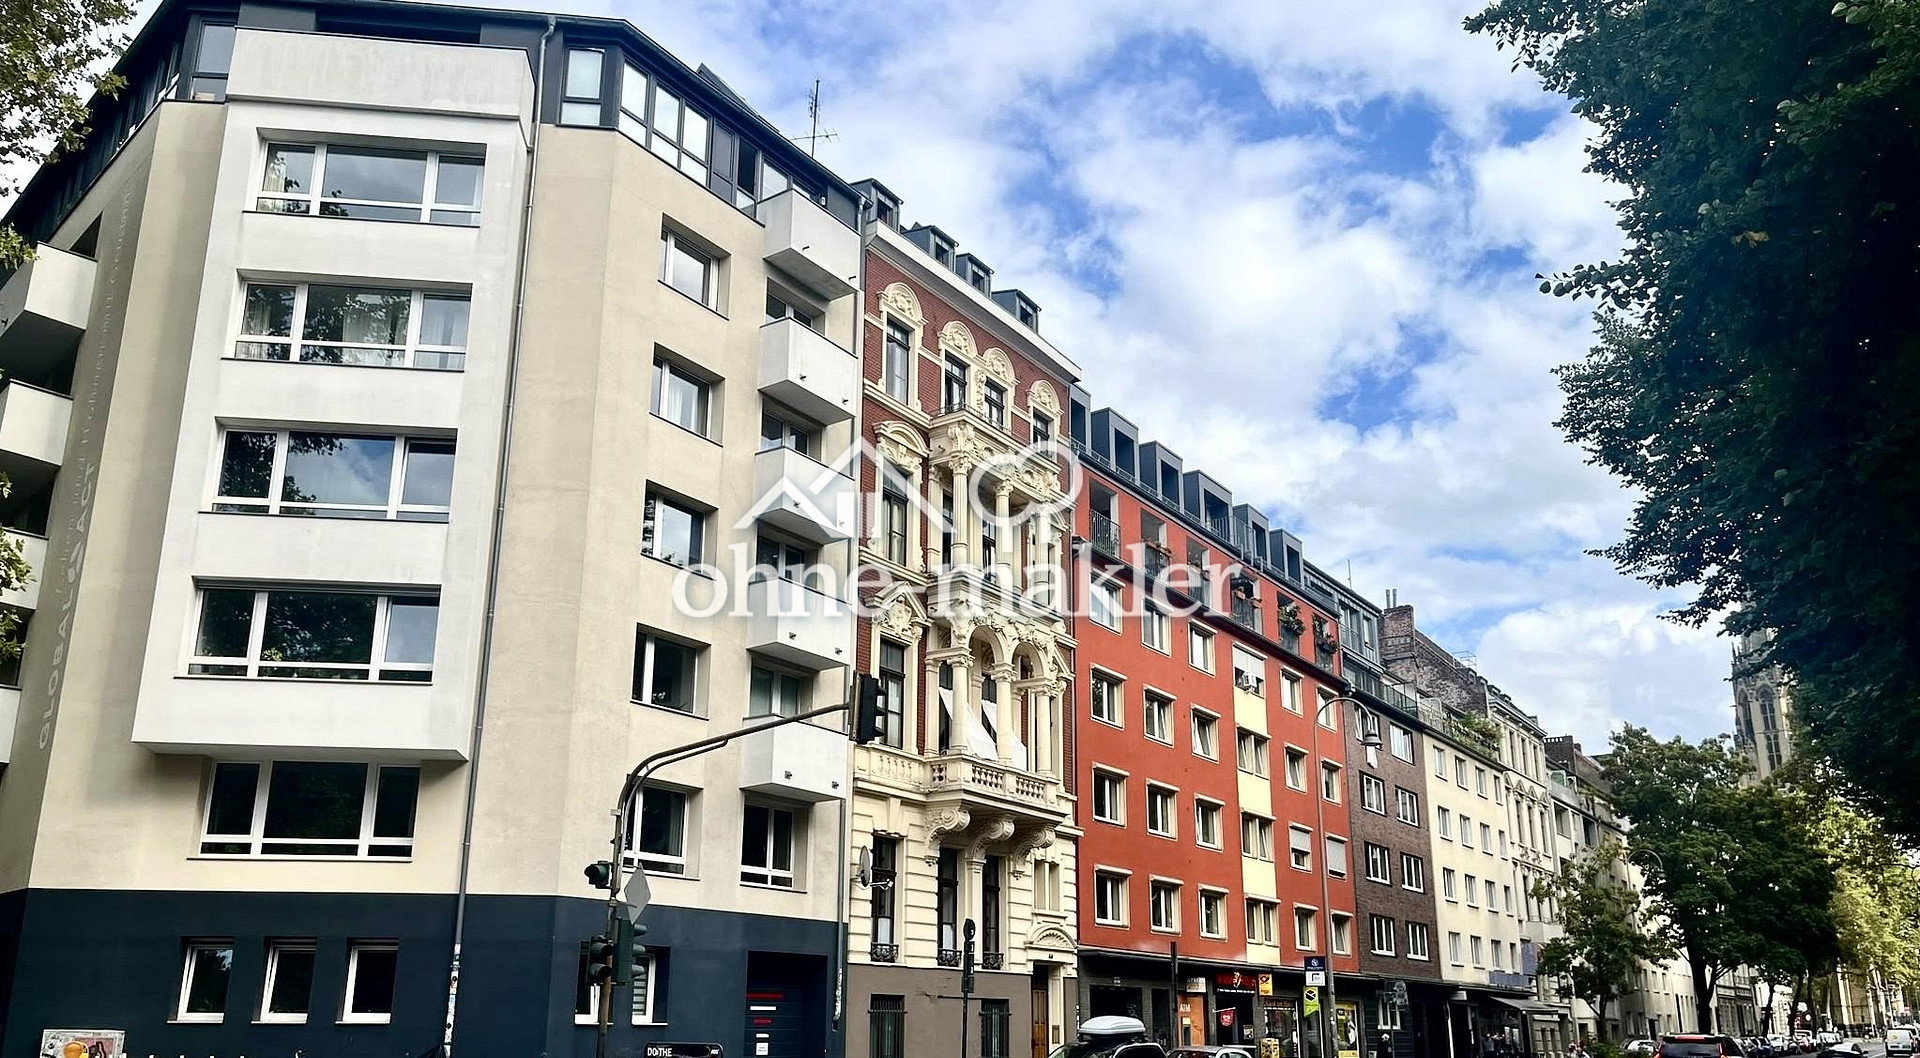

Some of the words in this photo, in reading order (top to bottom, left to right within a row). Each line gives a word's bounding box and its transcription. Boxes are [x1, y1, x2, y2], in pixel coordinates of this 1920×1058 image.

[38, 587, 74, 750] GLOBAL
[75, 462, 96, 533] ACT
[1179, 1003, 1191, 1013] ATM
